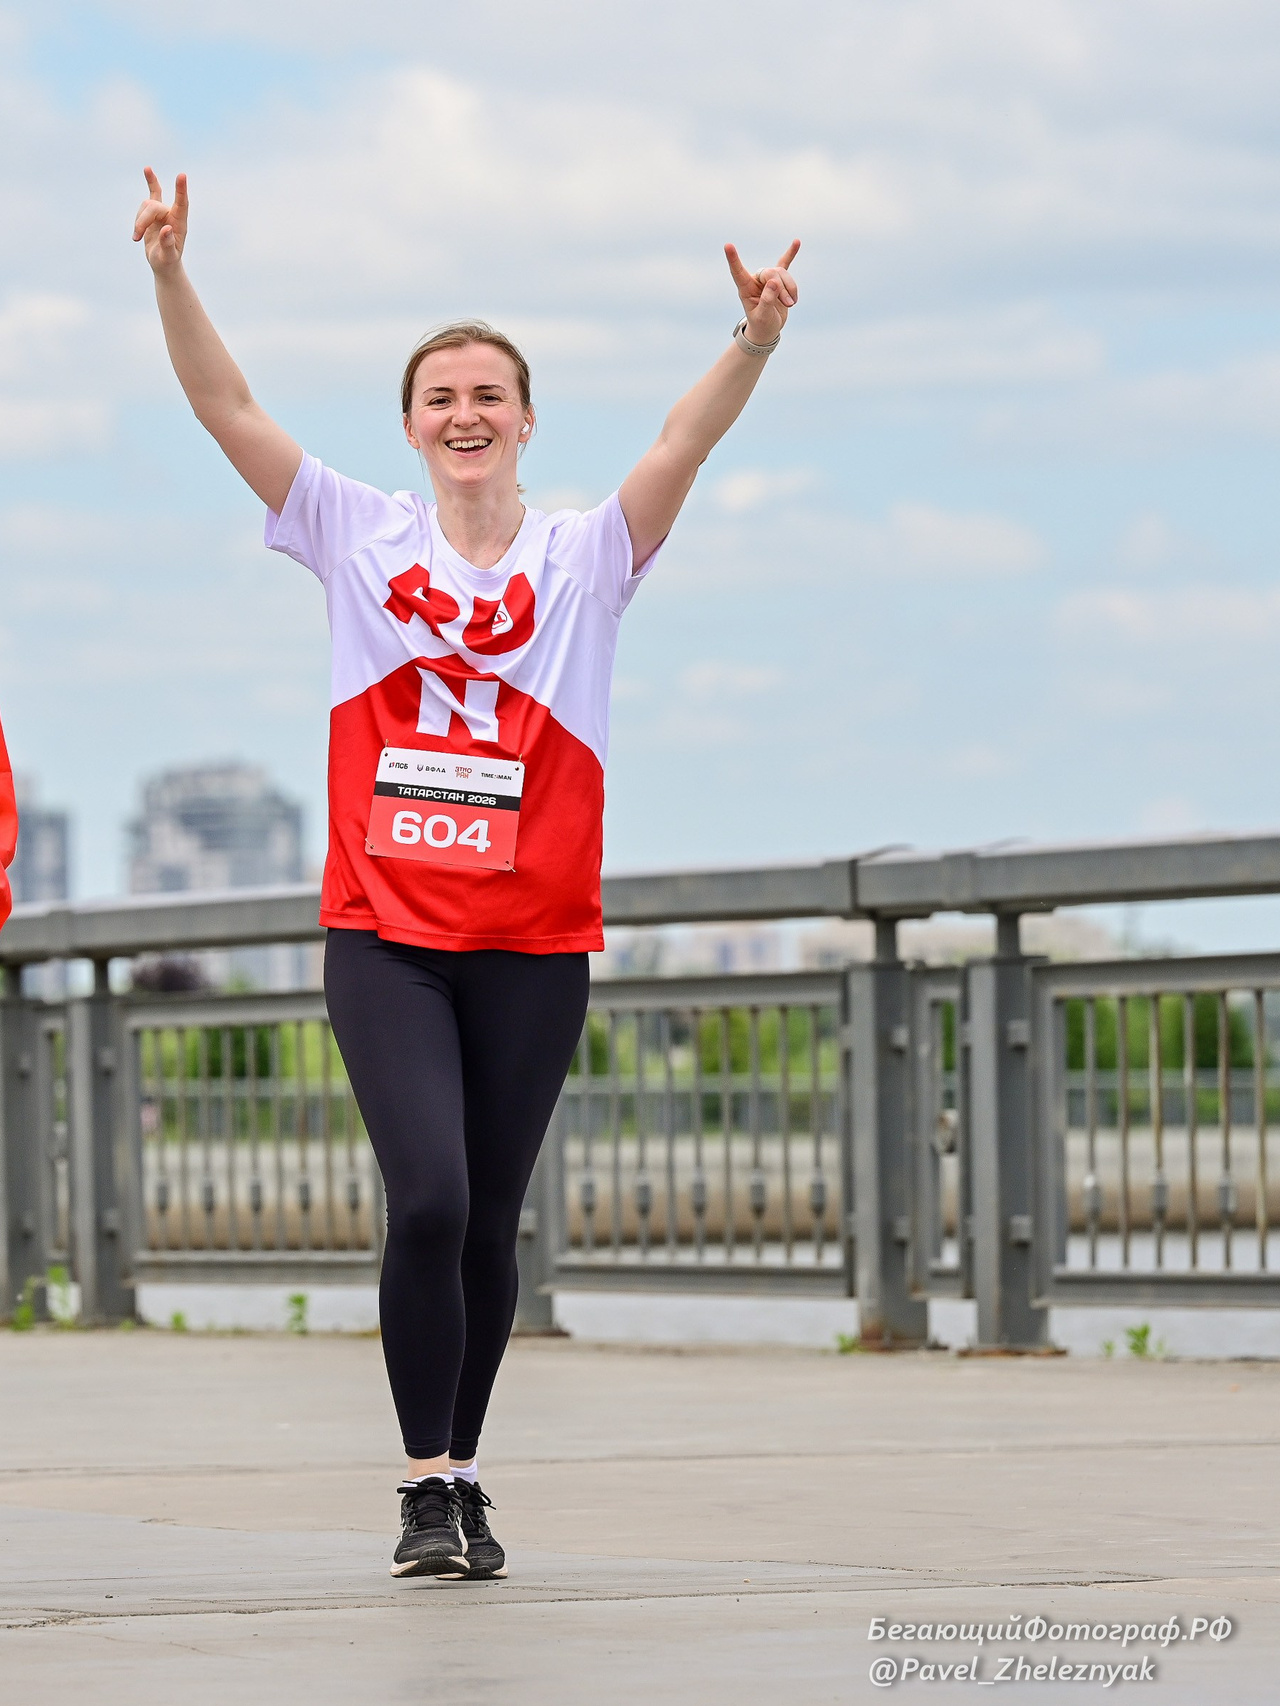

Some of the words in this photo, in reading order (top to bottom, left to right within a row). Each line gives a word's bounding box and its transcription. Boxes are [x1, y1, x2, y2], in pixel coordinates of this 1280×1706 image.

[415, 665, 500, 743] N
[395, 762, 409, 770] ПСБ
[397, 786, 465, 802] ТАТАРСТАН
[467, 794, 497, 806] 2026
[391, 810, 492, 853] 604
